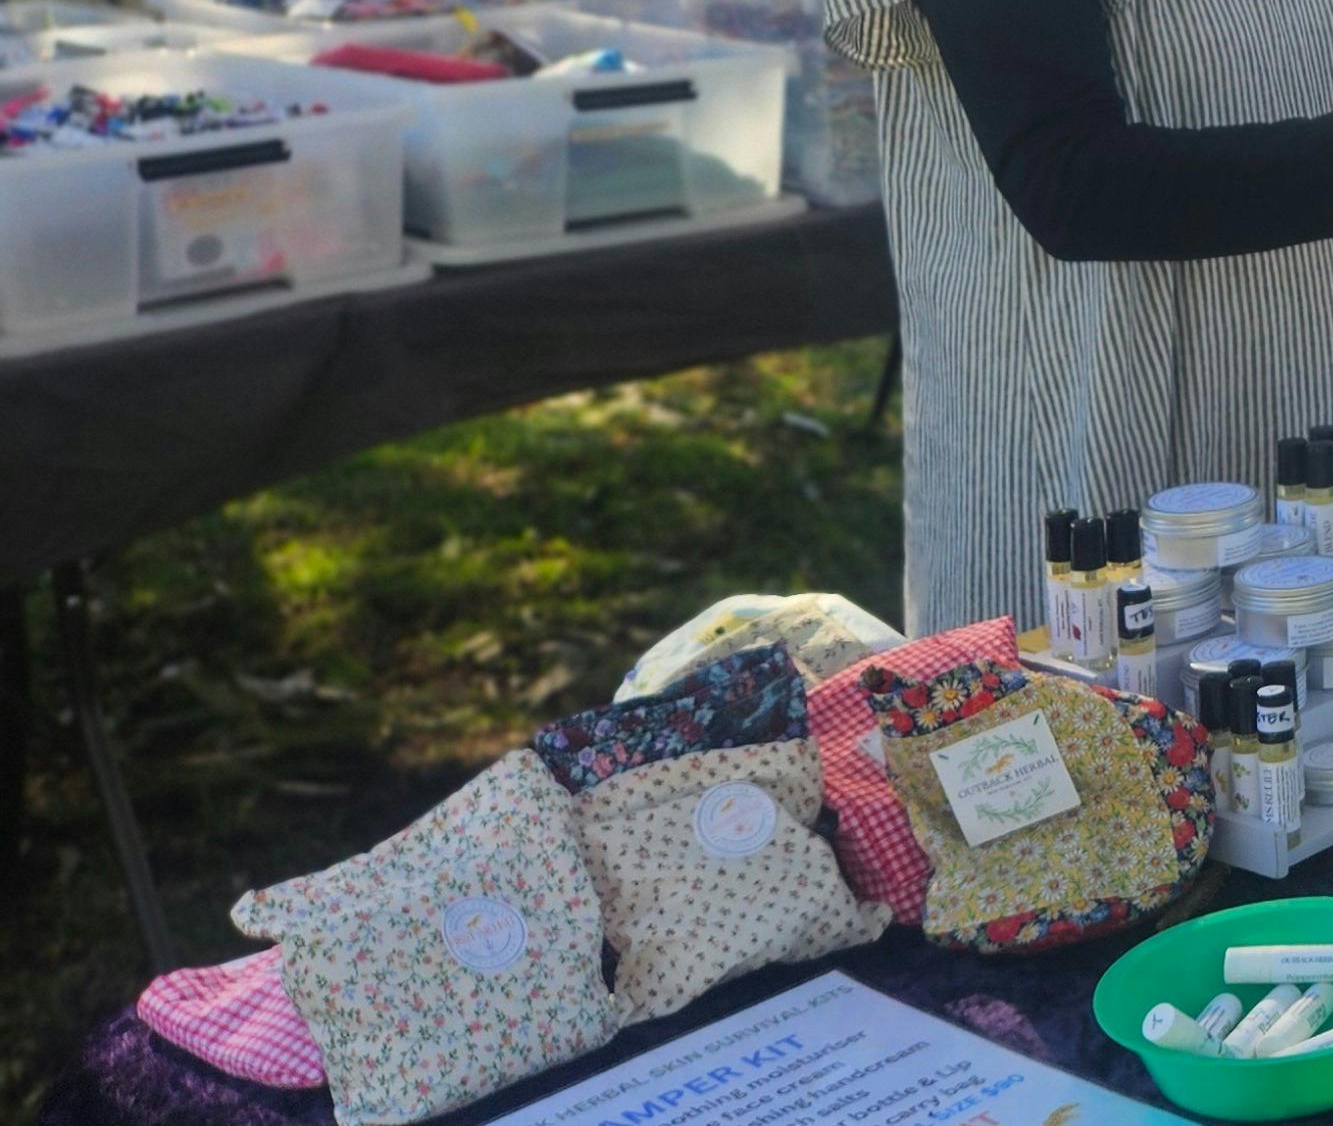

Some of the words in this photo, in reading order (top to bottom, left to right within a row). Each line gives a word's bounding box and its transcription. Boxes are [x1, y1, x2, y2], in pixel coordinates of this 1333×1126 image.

[957, 772, 1014, 799] OUTBACK
[1014, 754, 1059, 777] HERBAL
[555, 1077, 649, 1122] HERBAL
[648, 1050, 703, 1079] SKIN
[704, 1006, 809, 1054] SURVIVAL
[808, 984, 853, 1009] KITS
[741, 1033, 804, 1069] KIT
[747, 1029, 867, 1091] moisturiser
[807, 1039, 931, 1101] handcream
[721, 1094, 774, 1122] face
[776, 1060, 846, 1096] cream
[817, 1088, 871, 1118] salts
[848, 1085, 920, 1121] bottle
[917, 1076, 938, 1088] &
[886, 1094, 941, 1126] carry
[938, 1074, 986, 1097] bag
[927, 1093, 982, 1121] SIZE
